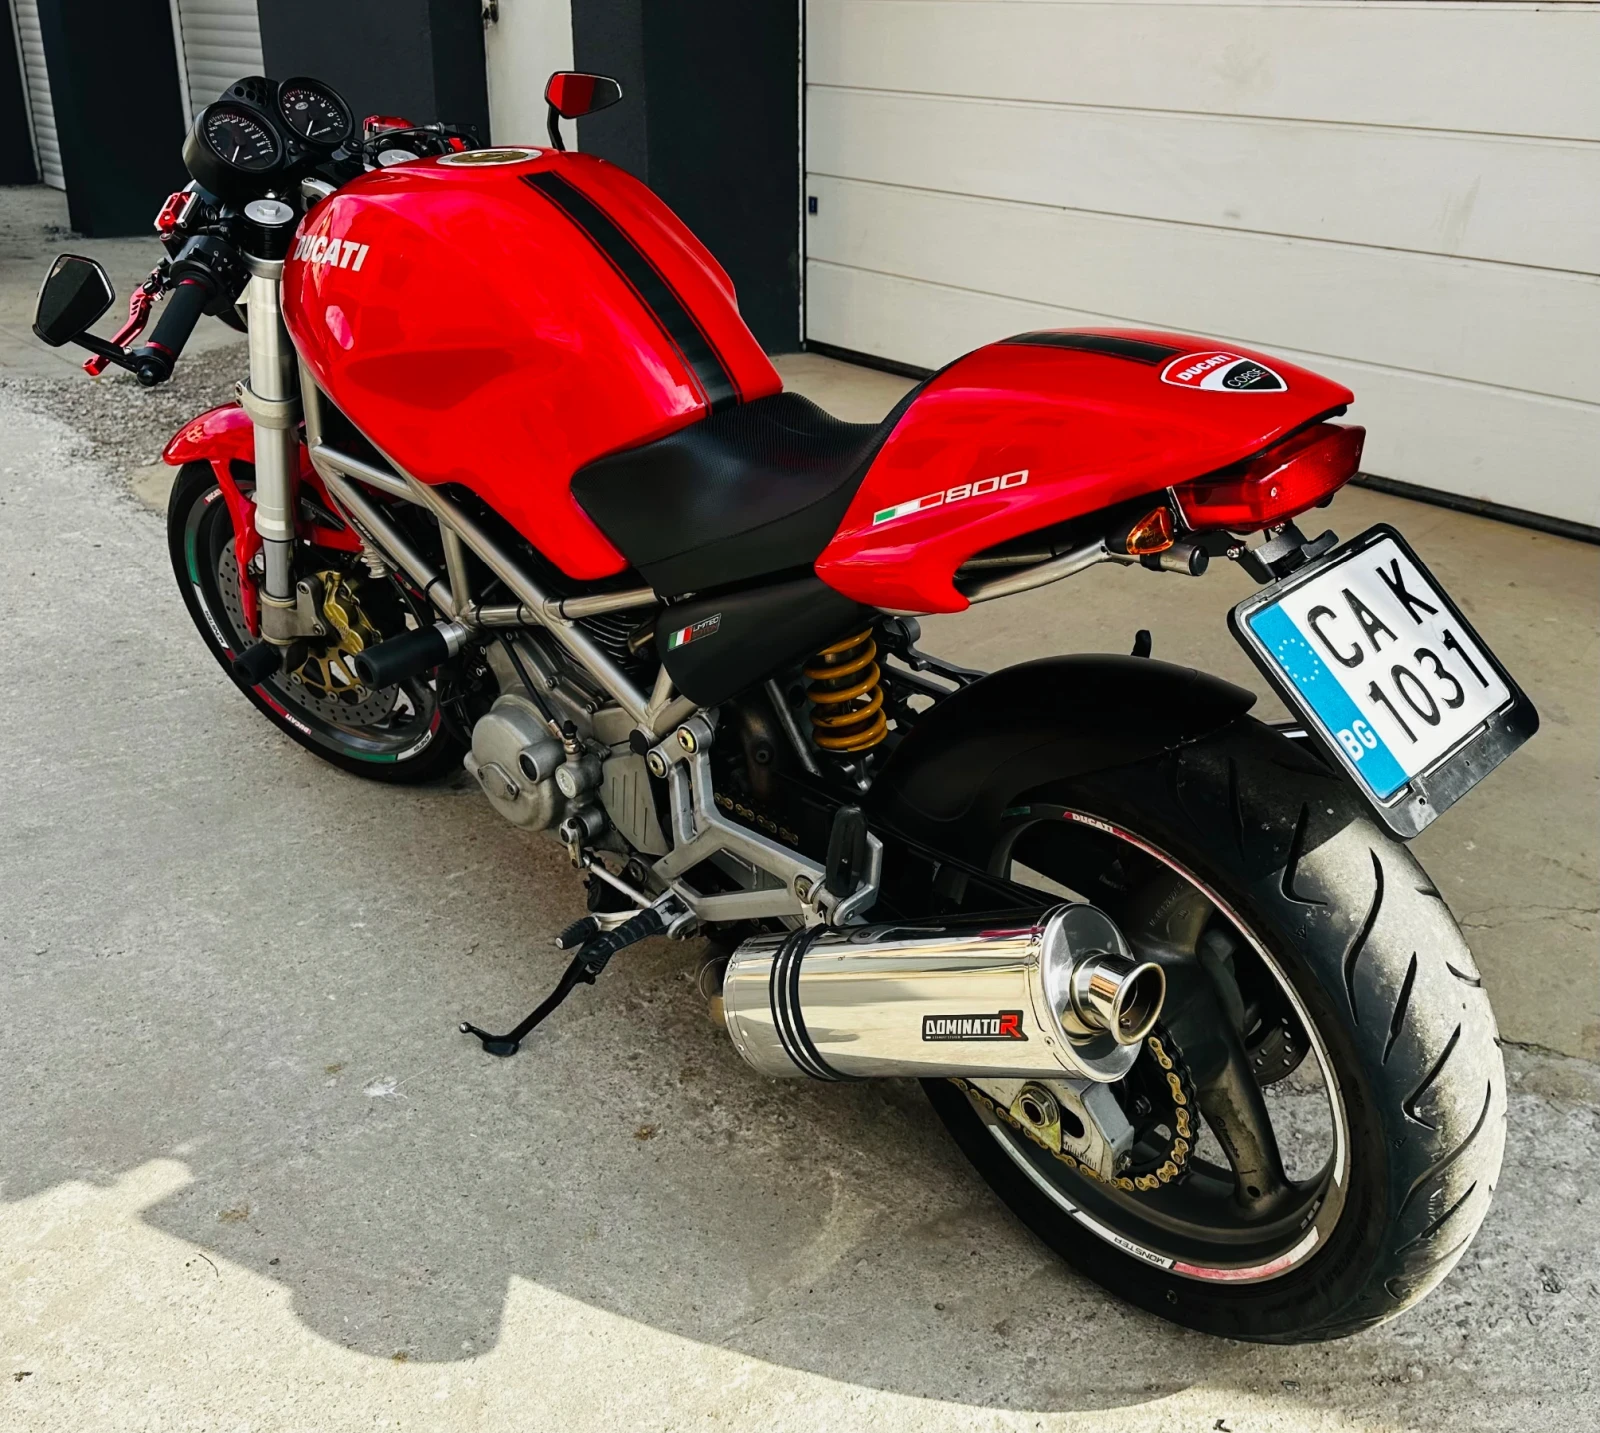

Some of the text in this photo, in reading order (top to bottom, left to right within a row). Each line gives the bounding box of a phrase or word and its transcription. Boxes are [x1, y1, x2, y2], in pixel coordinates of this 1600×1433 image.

[293, 235, 369, 272] DUCATI
[1176, 355, 1232, 381] DUCATI
[1227, 368, 1265, 387] CORSE
[945, 469, 1029, 504] 800
[1307, 558, 1439, 668] CA K
[1366, 628, 1490, 745] 1031
[1337, 719, 1378, 762] BG
[1072, 812, 1113, 833] DUCATI
[925, 1014, 1022, 1038] DOMINATOR
[1114, 1237, 1165, 1265] MONSTER
